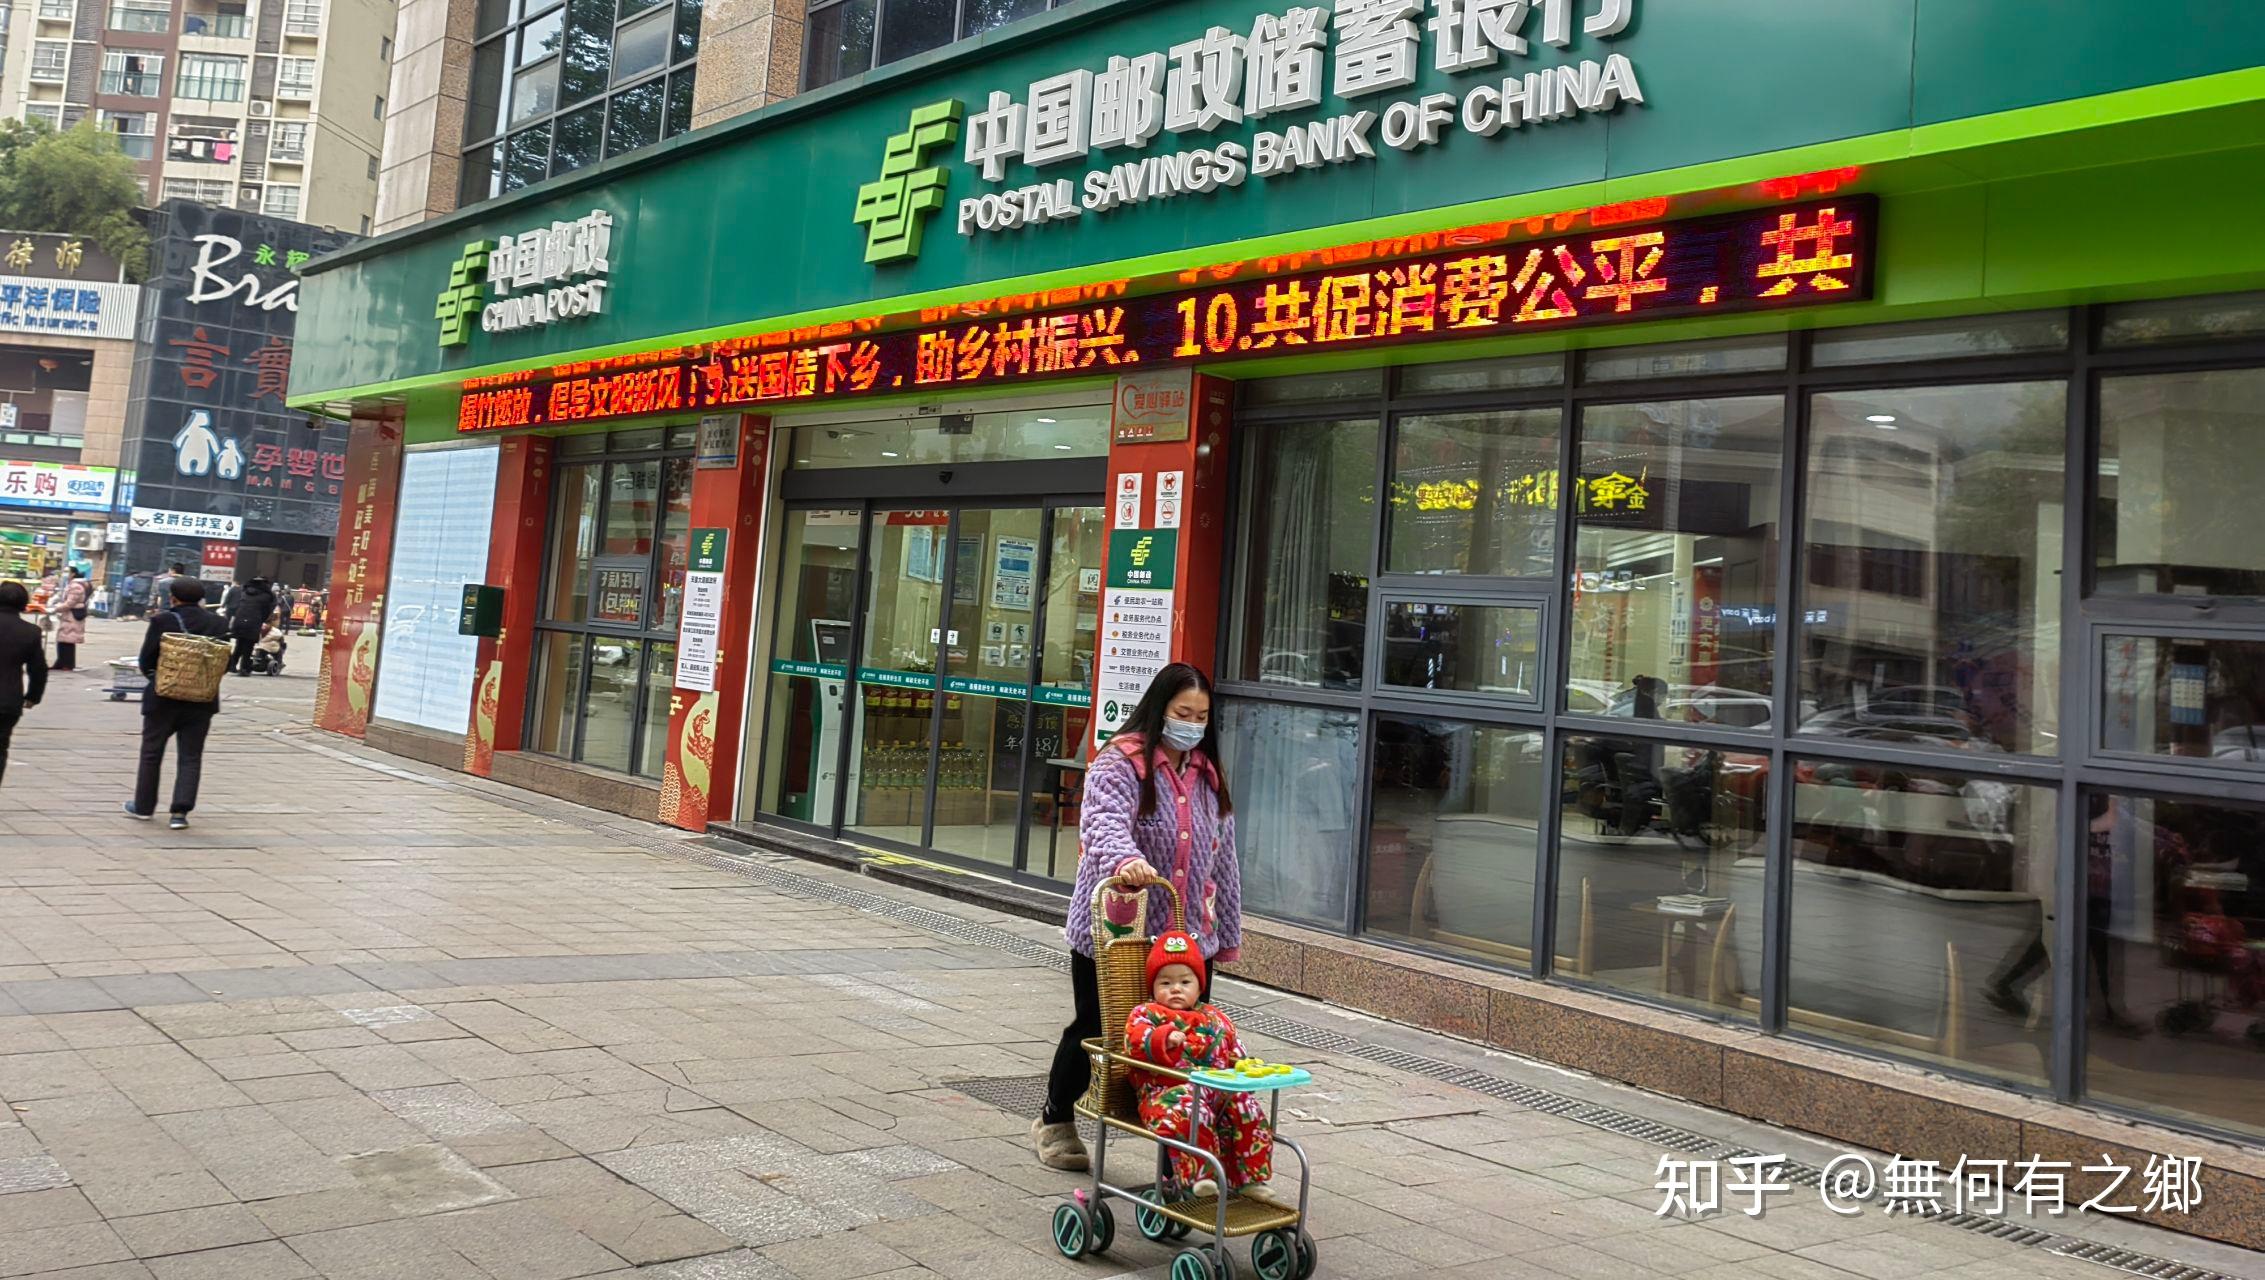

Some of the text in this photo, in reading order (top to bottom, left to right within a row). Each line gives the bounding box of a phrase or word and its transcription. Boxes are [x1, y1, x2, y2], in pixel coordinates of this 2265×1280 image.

[958, 53, 1645, 236] POSTAL SAVINGS BANK OF CHINA
[487, 209, 613, 295] 中国邮政
[482, 279, 608, 332] CHINA POST
[5, 471, 58, 497] 乐购
